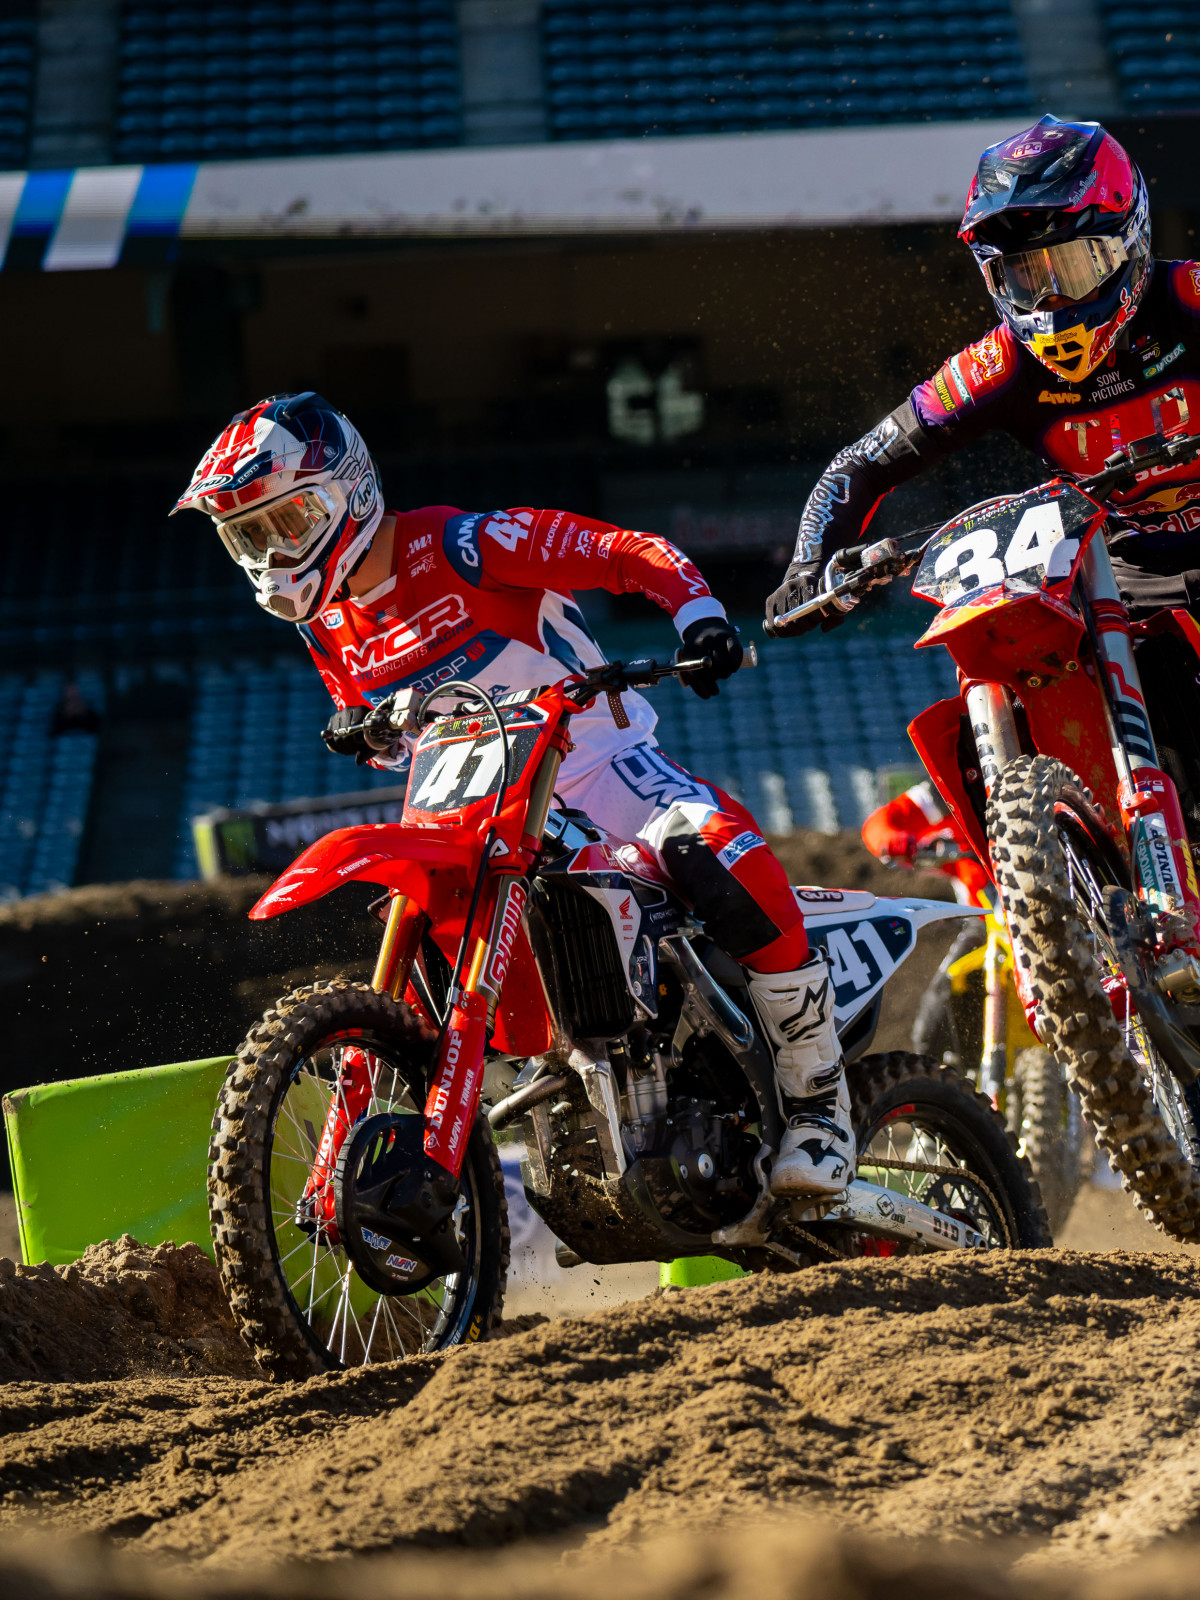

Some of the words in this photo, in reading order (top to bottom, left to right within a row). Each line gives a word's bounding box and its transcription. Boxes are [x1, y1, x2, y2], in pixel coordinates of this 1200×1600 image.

[1092, 379, 1135, 402] PICTURES
[1096, 370, 1120, 387] SONY
[357, 473, 375, 511] Arai
[1041, 488, 1069, 499] AMA
[977, 499, 1027, 522] MONSTER
[545, 512, 565, 548] HONDA
[934, 501, 1080, 604] 34
[341, 594, 470, 676] MCR
[334, 727, 352, 736] ASV
[412, 733, 517, 807] 41
[801, 891, 841, 900] GUTS
[826, 921, 896, 992] 41
[431, 1031, 463, 1129] DUNLOP
